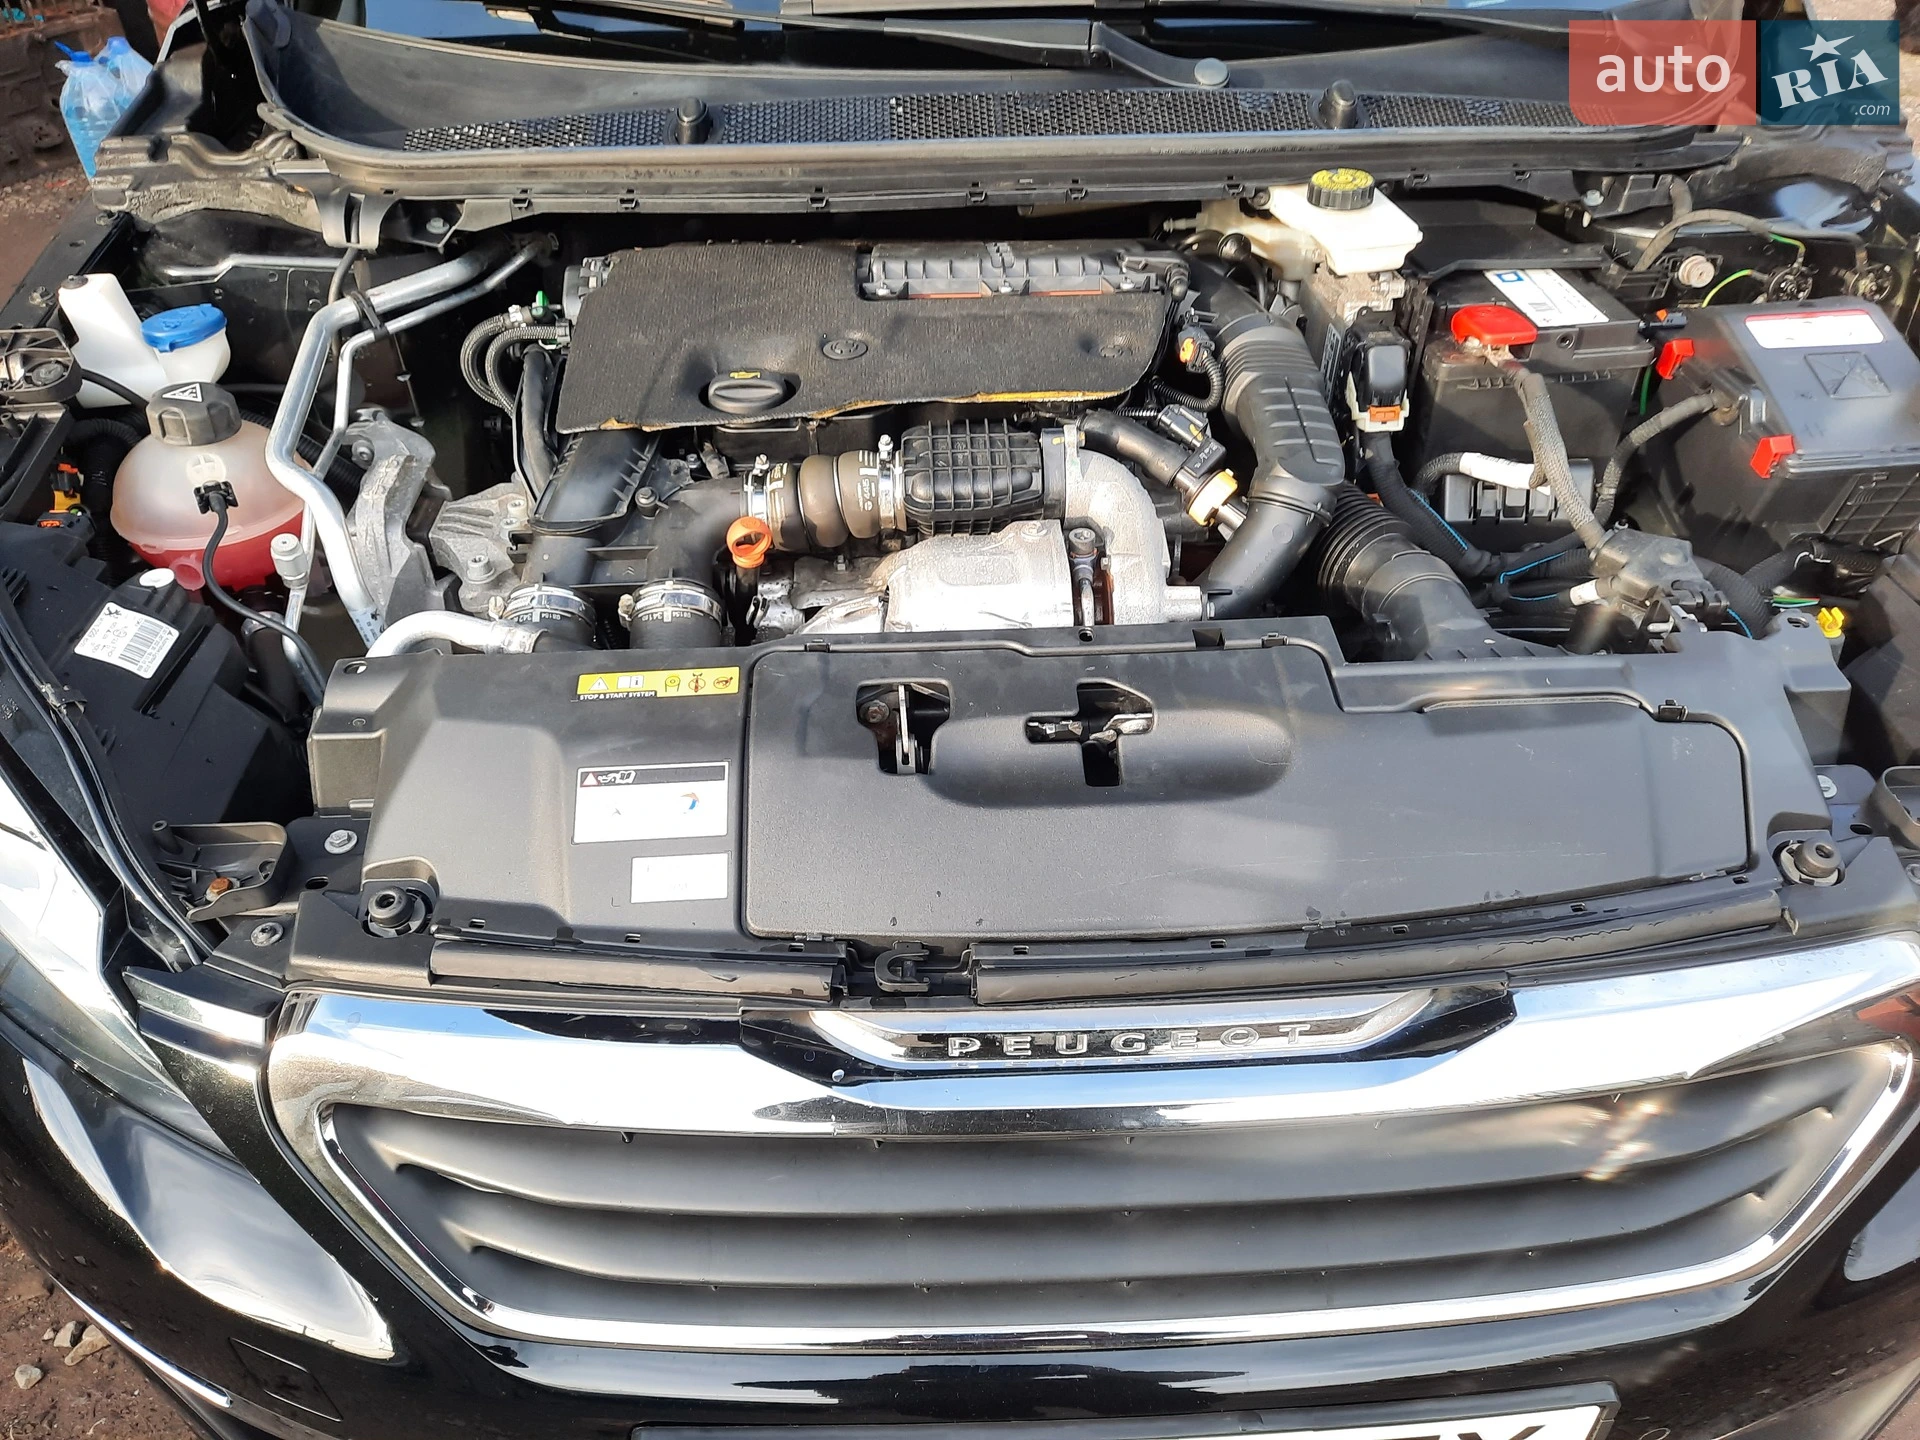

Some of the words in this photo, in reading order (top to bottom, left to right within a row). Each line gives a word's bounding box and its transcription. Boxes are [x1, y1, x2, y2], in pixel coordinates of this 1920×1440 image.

[580, 693, 599, 701] STOP
[605, 690, 628, 699] START
[628, 690, 655, 699] SYSTEM
[948, 1024, 1311, 1057] PEUGEOT
